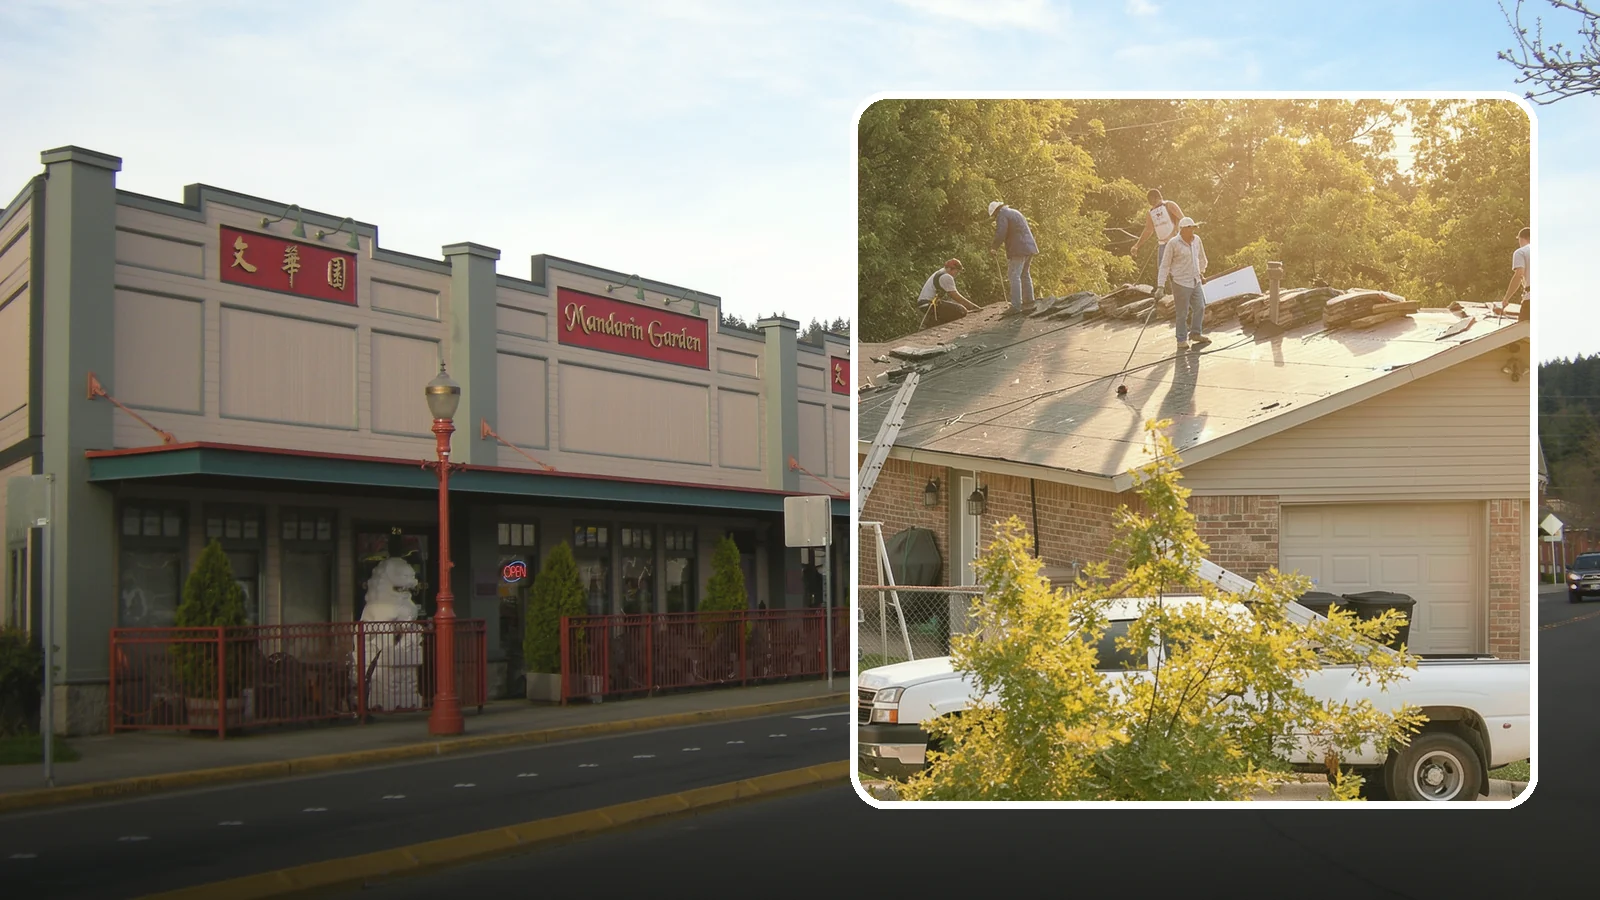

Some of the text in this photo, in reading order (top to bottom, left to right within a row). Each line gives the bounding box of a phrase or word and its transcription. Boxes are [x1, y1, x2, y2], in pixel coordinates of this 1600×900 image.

[231, 235, 347, 291] 文華園
[564, 302, 701, 352] Mandarin Garden
[503, 565, 527, 578] OPEN
